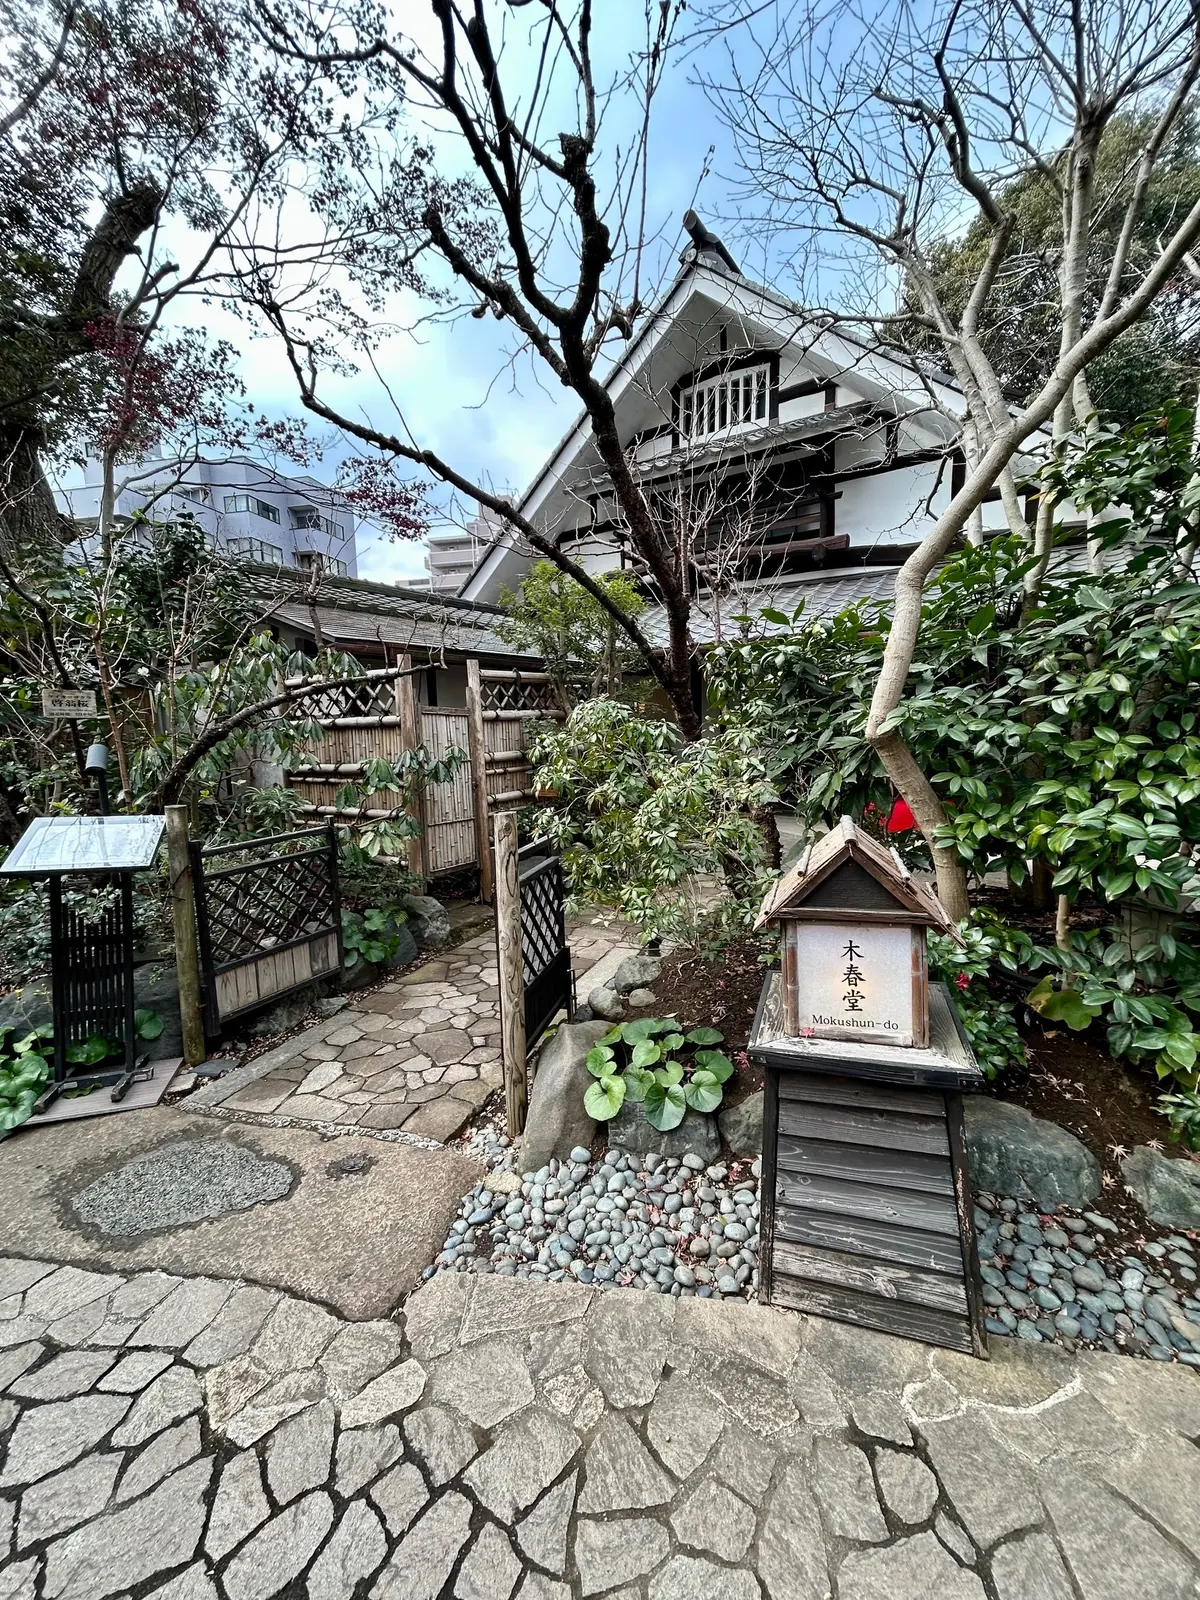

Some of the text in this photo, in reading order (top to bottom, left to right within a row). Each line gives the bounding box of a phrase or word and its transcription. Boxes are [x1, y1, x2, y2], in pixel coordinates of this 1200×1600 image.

[841, 940, 866, 1011] 木春堂
[812, 1014, 899, 1030] Mokushun-do
